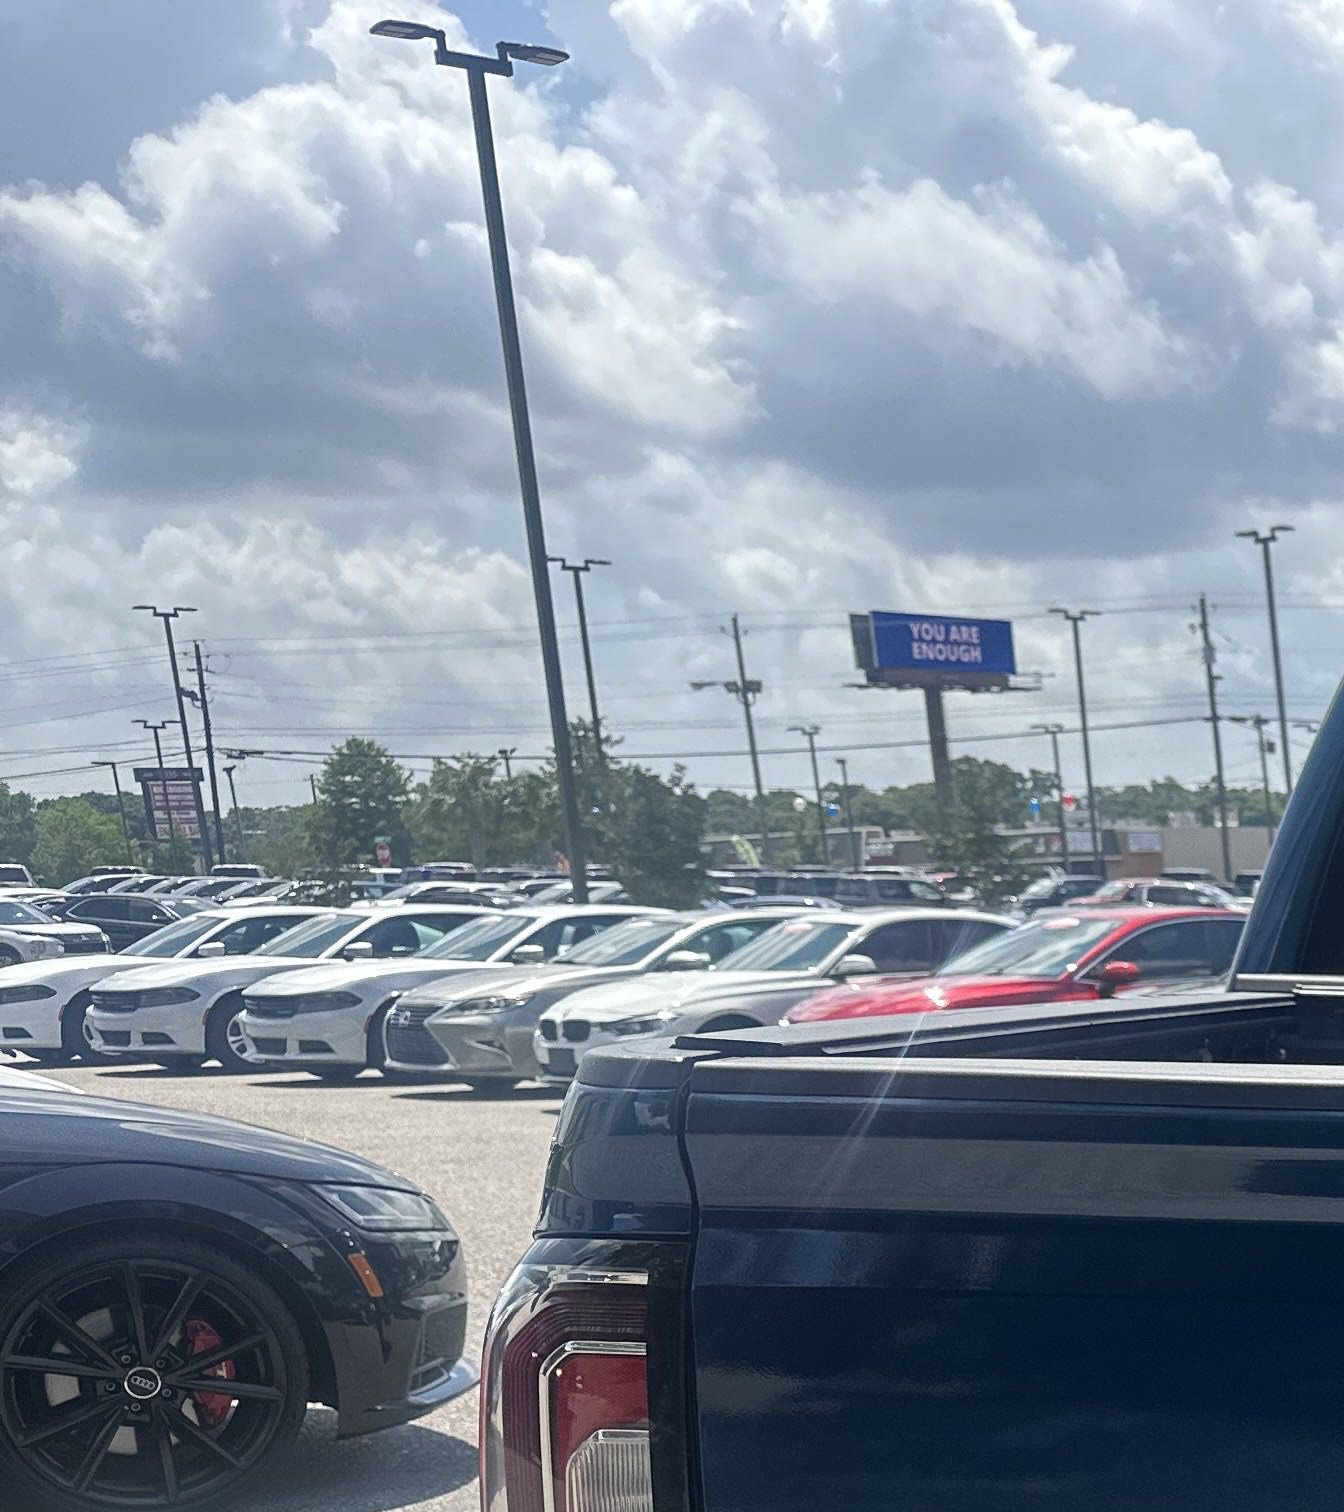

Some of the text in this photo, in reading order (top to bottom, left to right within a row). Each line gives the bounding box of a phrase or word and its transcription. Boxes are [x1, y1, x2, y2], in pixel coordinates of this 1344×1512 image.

[910, 622, 981, 644] YOU ARE
[911, 641, 983, 663] ENOUGH
